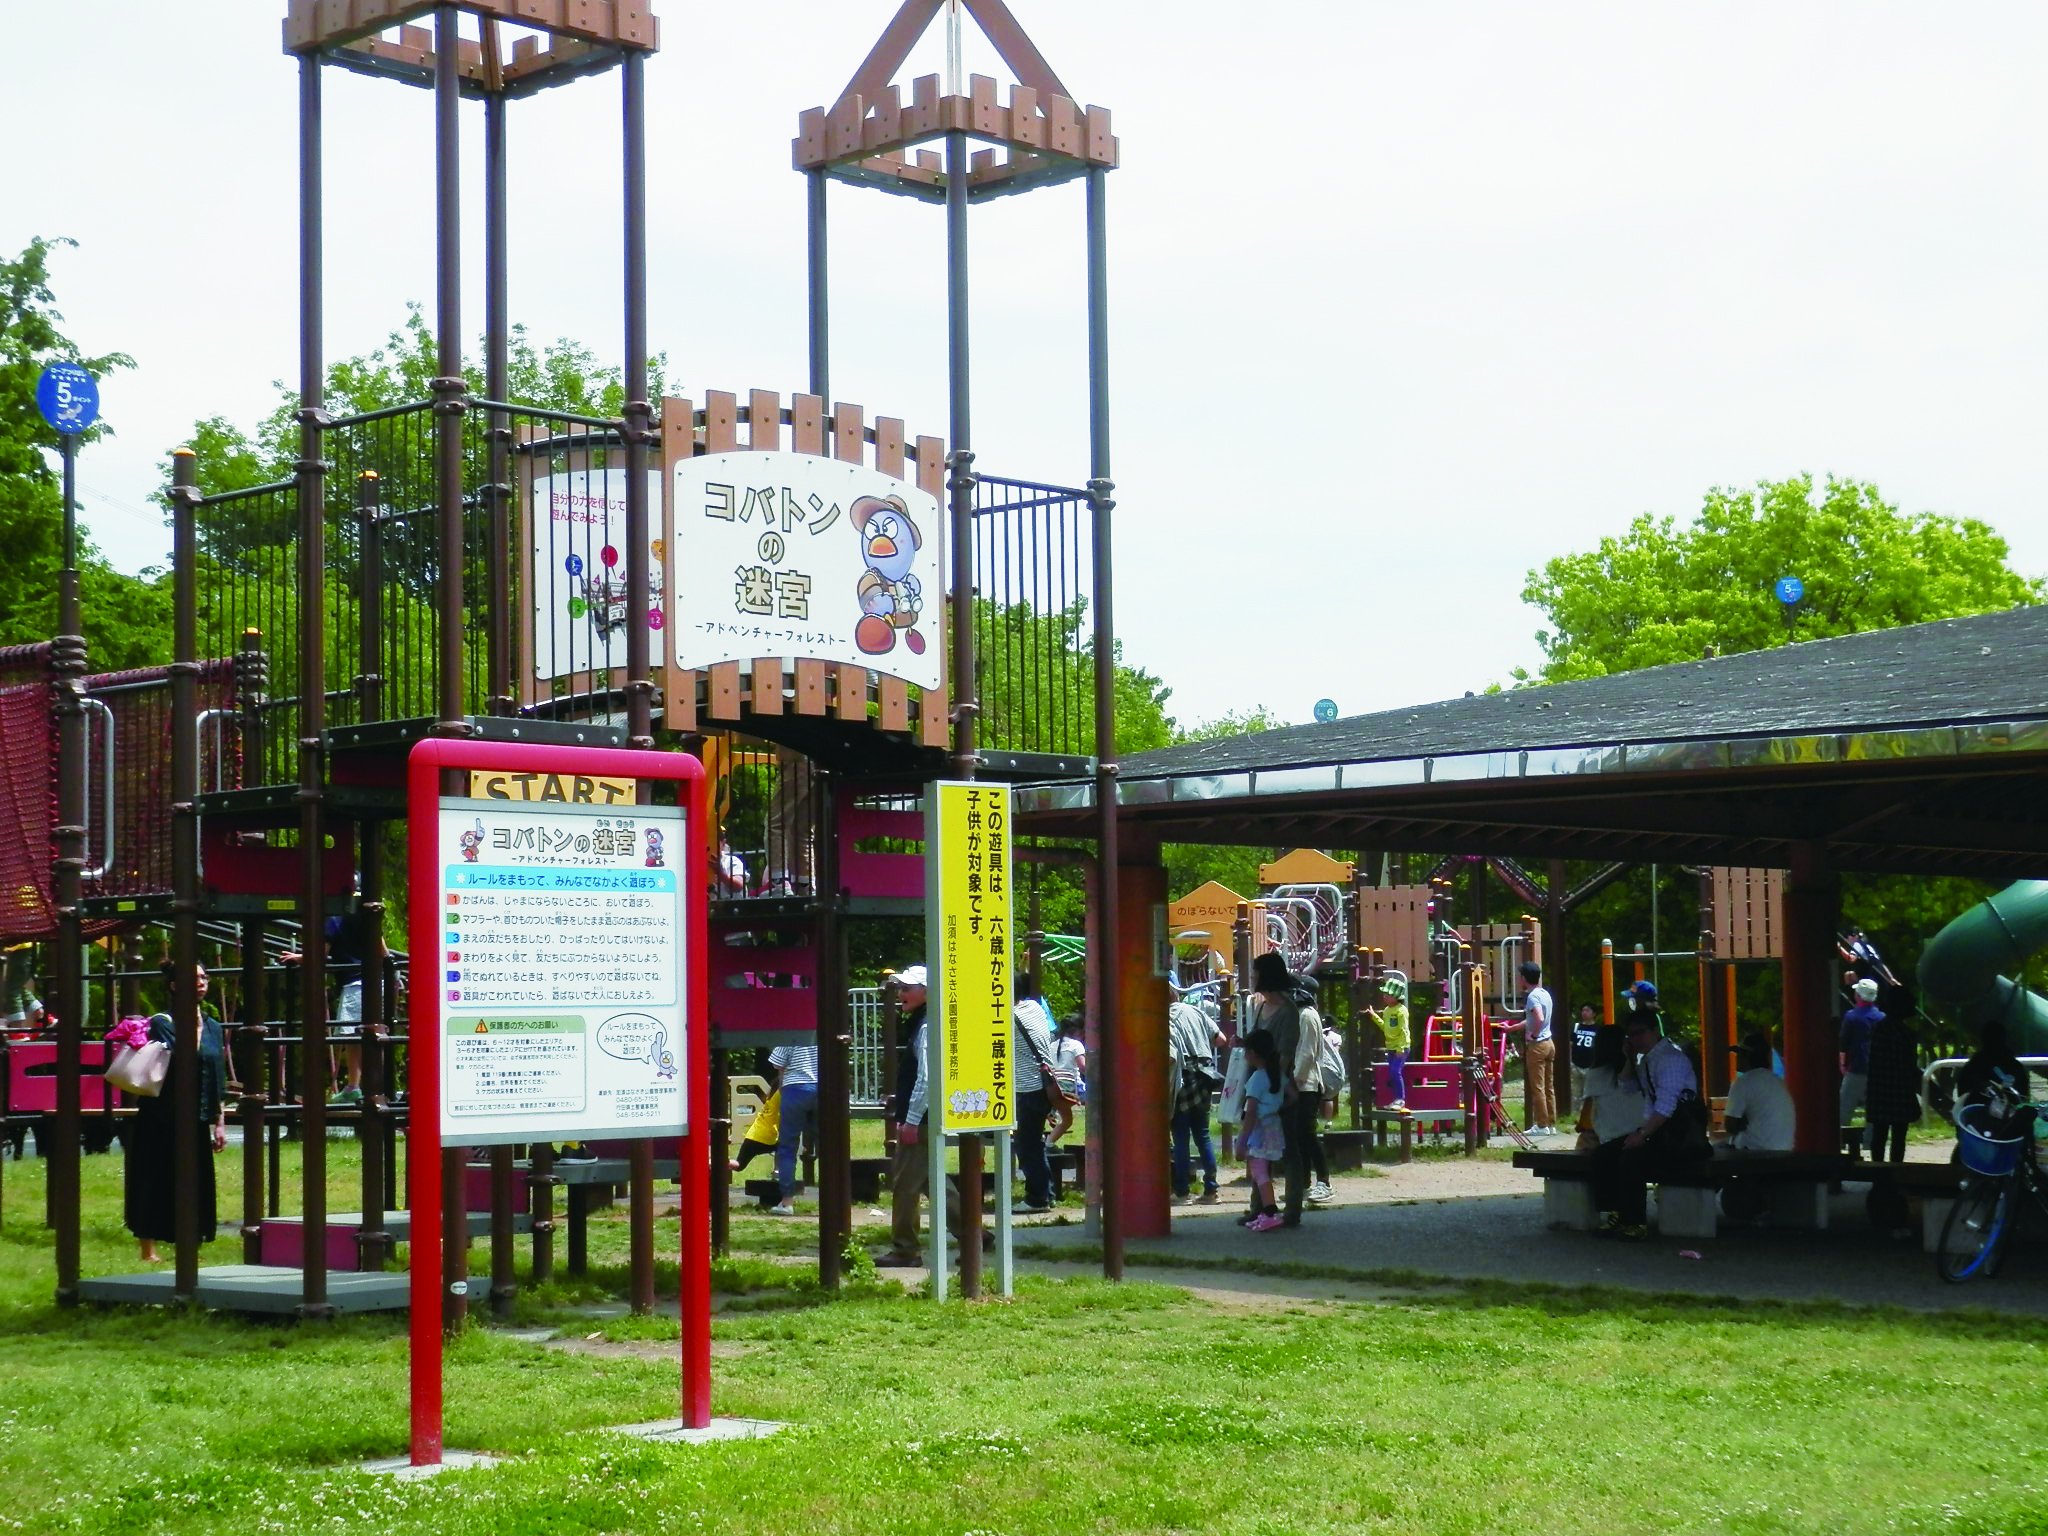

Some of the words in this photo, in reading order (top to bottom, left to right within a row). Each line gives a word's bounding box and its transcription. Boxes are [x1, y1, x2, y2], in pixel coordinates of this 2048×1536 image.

[57, 381, 73, 404] 5
[704, 481, 841, 536] コバトン
[757, 531, 785, 565] の
[734, 565, 811, 621] 迷宮
[486, 774, 625, 804] START
[493, 826, 636, 856] コバトンの迷宮
[966, 790, 984, 942] 子供が対象です。
[453, 933, 460, 943] 3
[1577, 1035, 1593, 1047] 78
